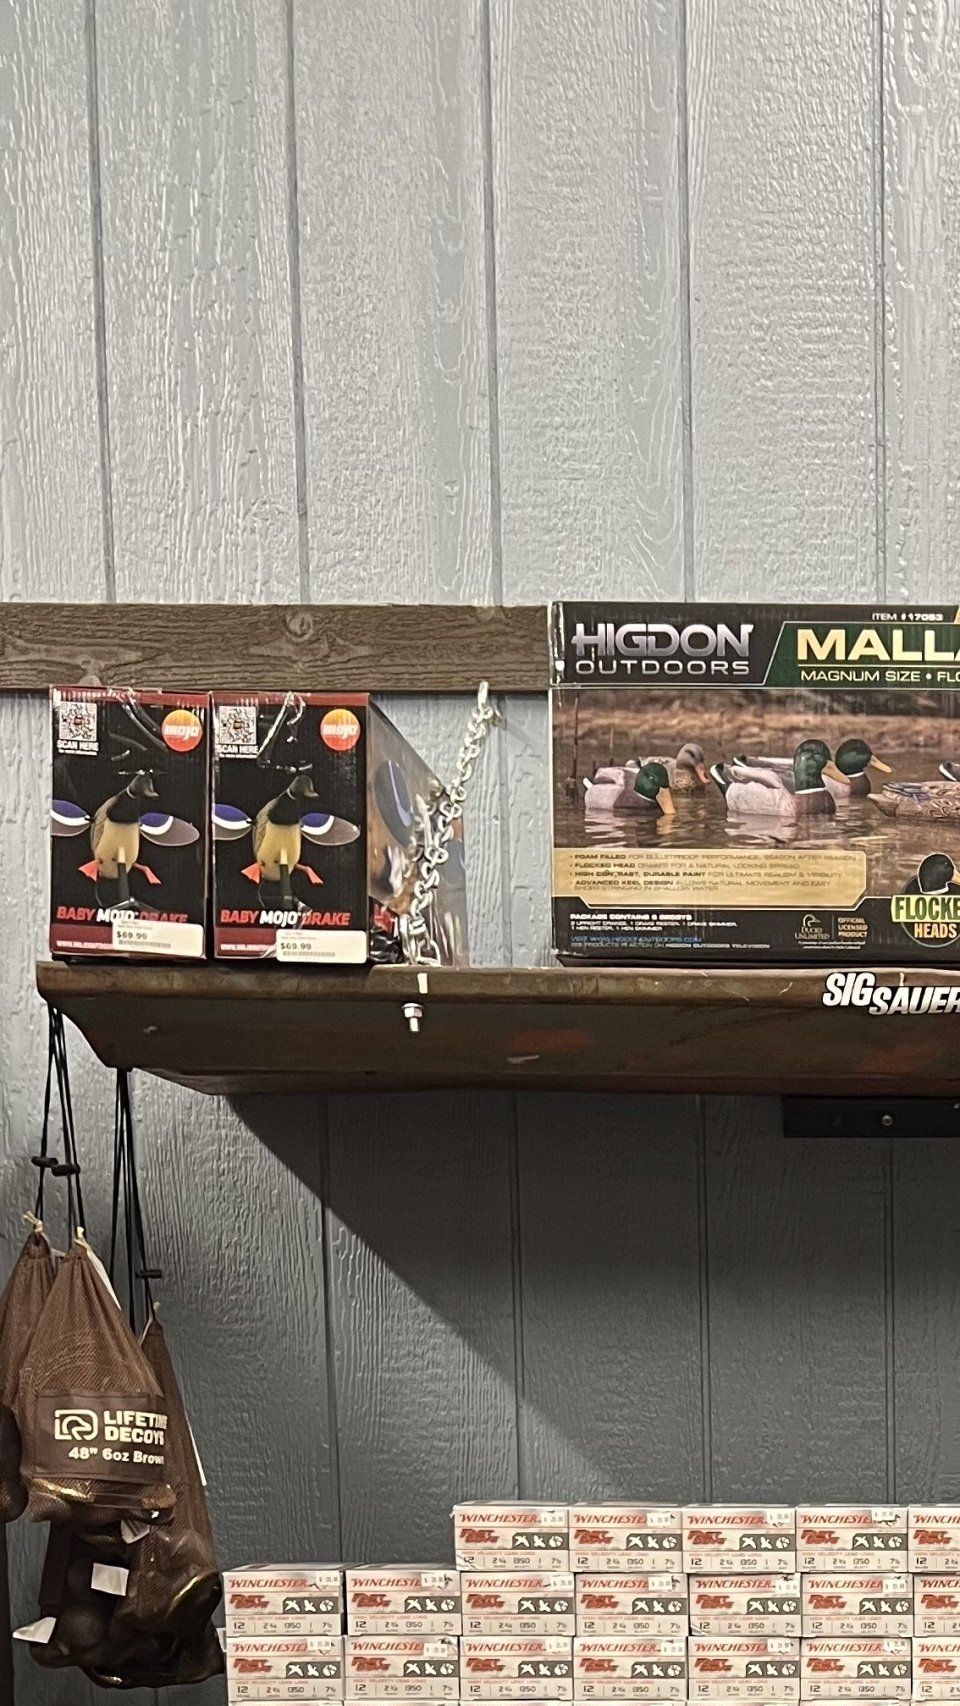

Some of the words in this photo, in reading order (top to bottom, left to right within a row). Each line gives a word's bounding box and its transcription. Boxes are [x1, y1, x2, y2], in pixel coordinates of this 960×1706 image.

[872, 613, 897, 622] ITEM
[571, 623, 754, 657] HIGDON
[575, 660, 750, 676] OUTDOORS
[801, 670, 880, 683] MAGNUM
[885, 671, 921, 683] SIZE
[79, 741, 99, 752] HERE
[56, 906, 95, 921] BABY
[220, 909, 259, 924] BABY
[259, 910, 298, 926] MOJO
[303, 911, 351, 926] DRAKE
[116, 931, 148, 941] $69.99
[913, 922, 958, 939] HEADS
[280, 942, 312, 951] $69.99
[822, 972, 877, 1008] SIG
[104, 1426, 165, 1446] DECOYS
[102, 1447, 130, 1463] 6oz
[460, 1513, 537, 1524] WINCHESTER
[687, 1515, 765, 1525] WINCHESTER
[229, 1578, 307, 1589] WINCHESTER
[466, 1578, 544, 1589] WINCHESTER
[695, 1579, 772, 1589] WINCHESTER
[467, 1642, 543, 1653] WINCHESTER
